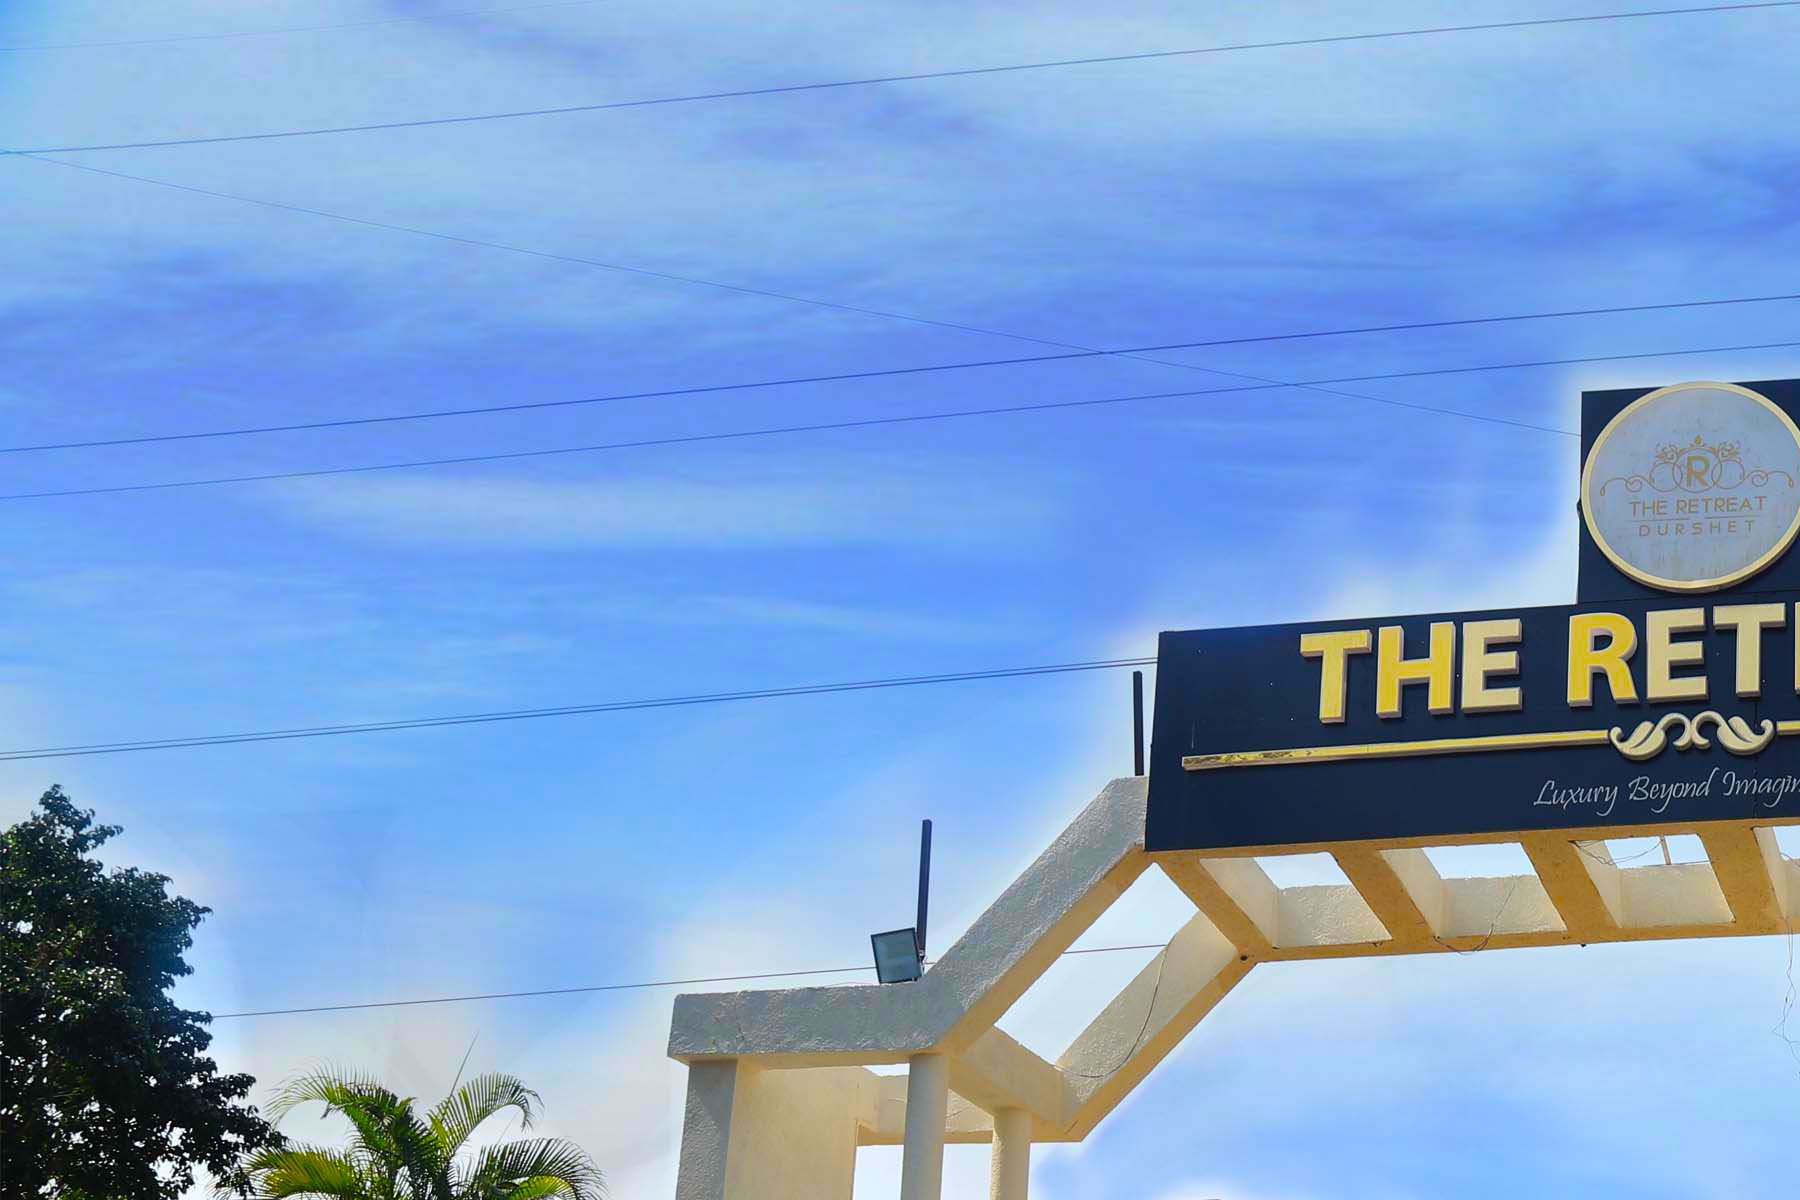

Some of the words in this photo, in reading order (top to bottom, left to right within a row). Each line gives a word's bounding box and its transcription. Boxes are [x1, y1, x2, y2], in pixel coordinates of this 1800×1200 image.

[1630, 501, 1668, 517] THE
[1676, 495, 1767, 514] RETREAT
[1639, 519, 1756, 537] DURSHET
[1300, 618, 1523, 724] THE
[1533, 780, 1619, 816] Luxury
[1628, 767, 1720, 813] Beyond
